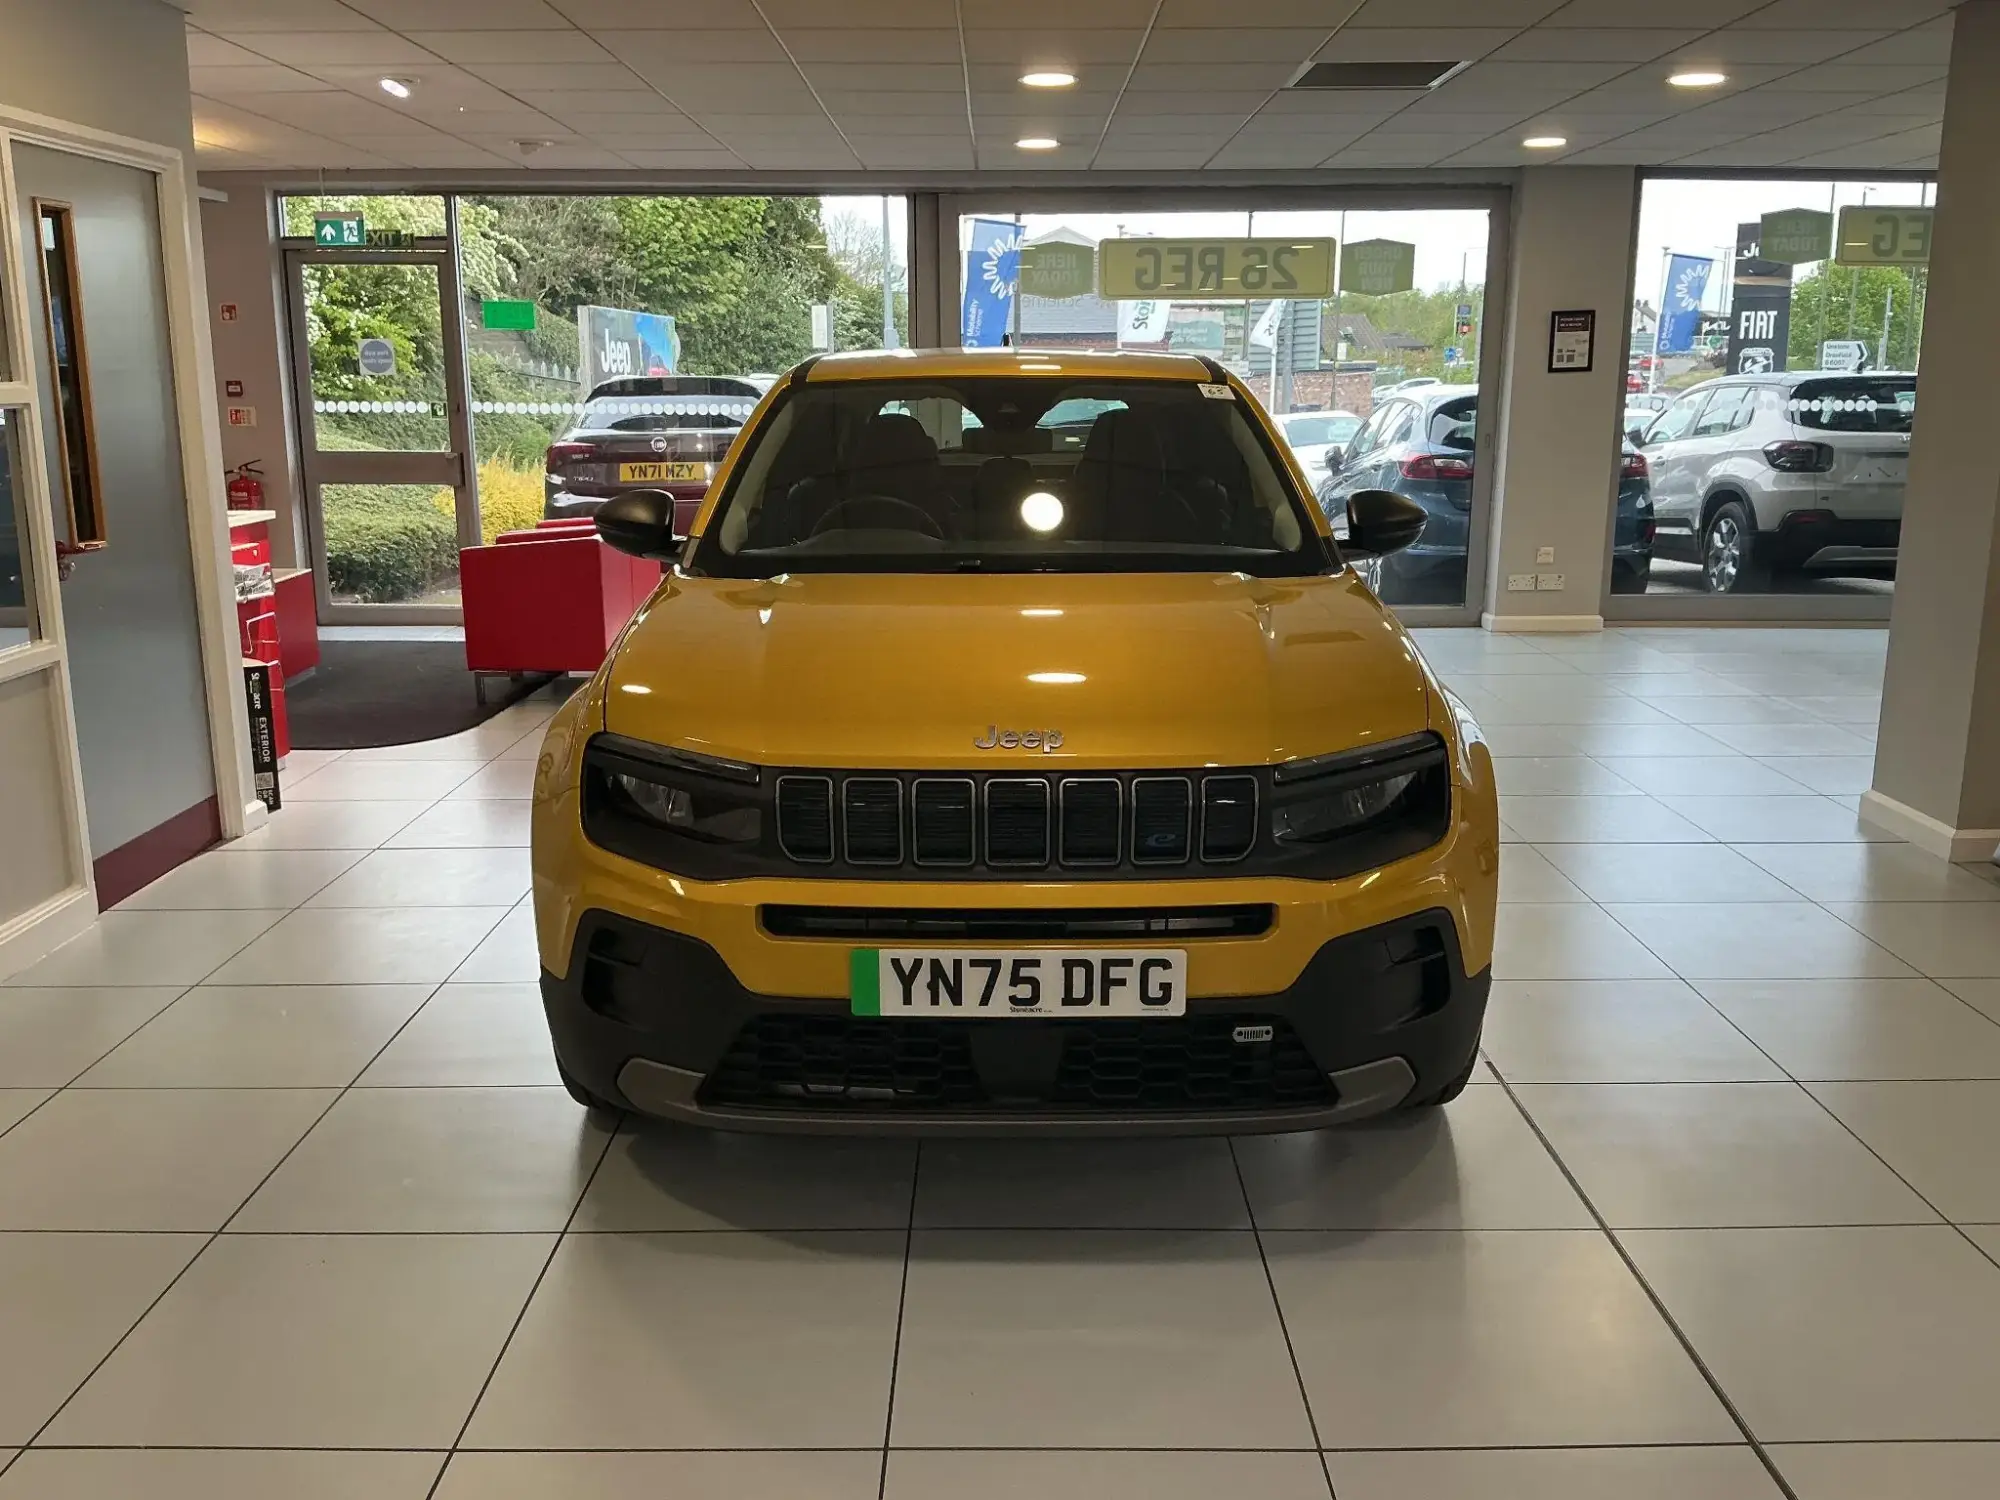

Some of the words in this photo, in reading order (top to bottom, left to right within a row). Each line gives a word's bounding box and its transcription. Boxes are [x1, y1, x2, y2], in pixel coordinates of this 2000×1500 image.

[1739, 311, 1777, 340] FIAT
[601, 328, 631, 376] Jeep
[629, 465, 661, 479] YN71
[666, 465, 694, 479] MZY
[259, 717, 271, 764] EXTERIOR
[973, 723, 1065, 754] Jeep
[890, 958, 1042, 1007] YN75
[1061, 958, 1172, 1007] DFG
